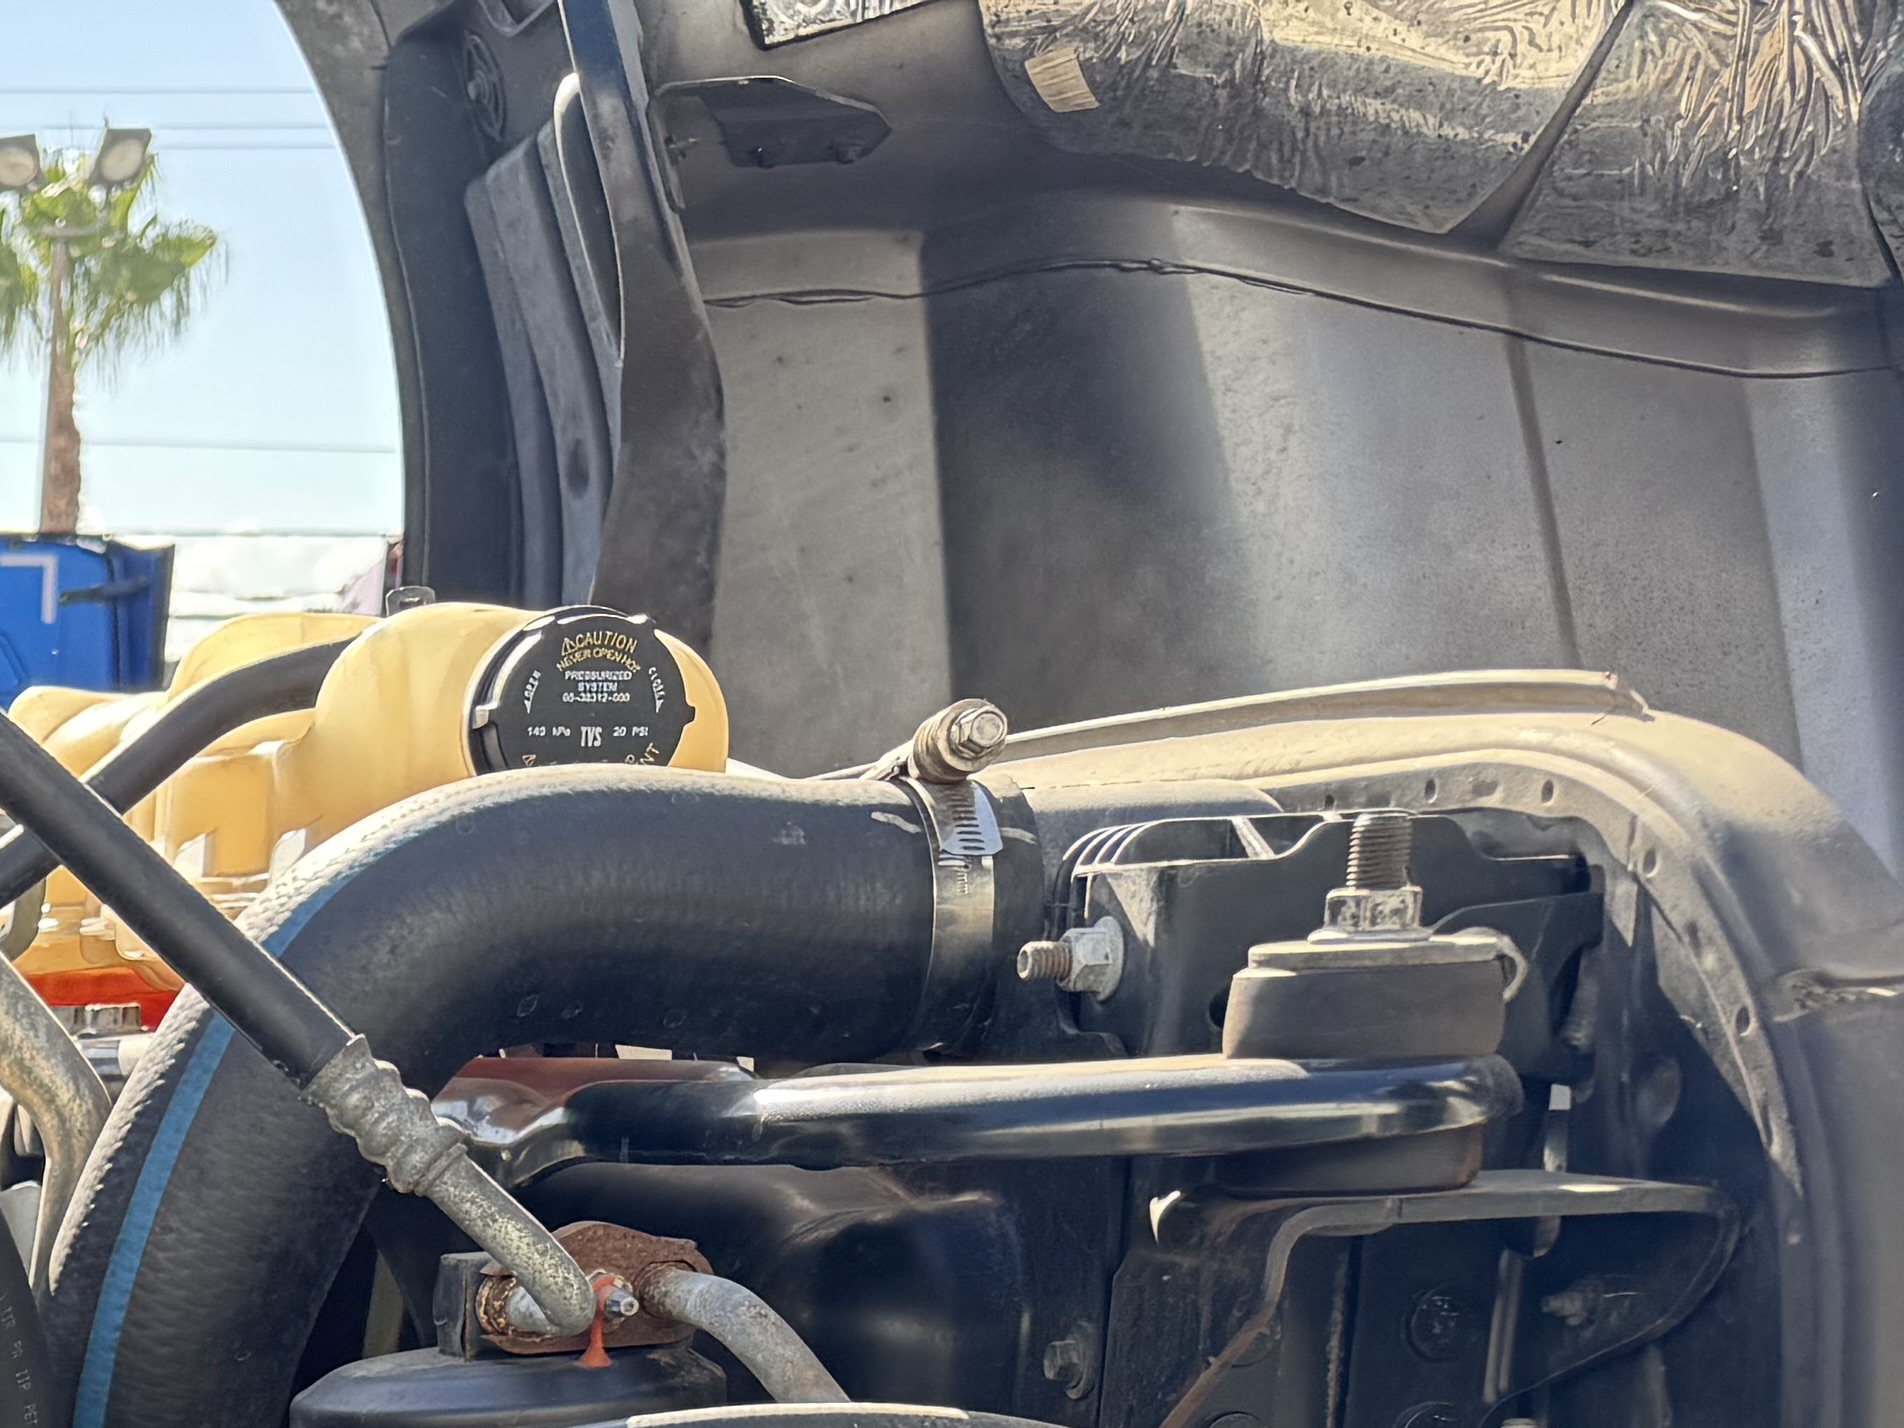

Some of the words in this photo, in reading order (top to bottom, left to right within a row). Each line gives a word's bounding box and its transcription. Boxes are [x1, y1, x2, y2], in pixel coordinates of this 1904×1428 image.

[576, 630, 638, 653] CAUTION
[556, 648, 592, 672] NEVER
[592, 647, 622, 662] OPEN
[577, 681, 618, 692] SYSTEM
[580, 726, 603, 747] TVS
[613, 726, 627, 737] 20
[632, 726, 649, 737] PSI
